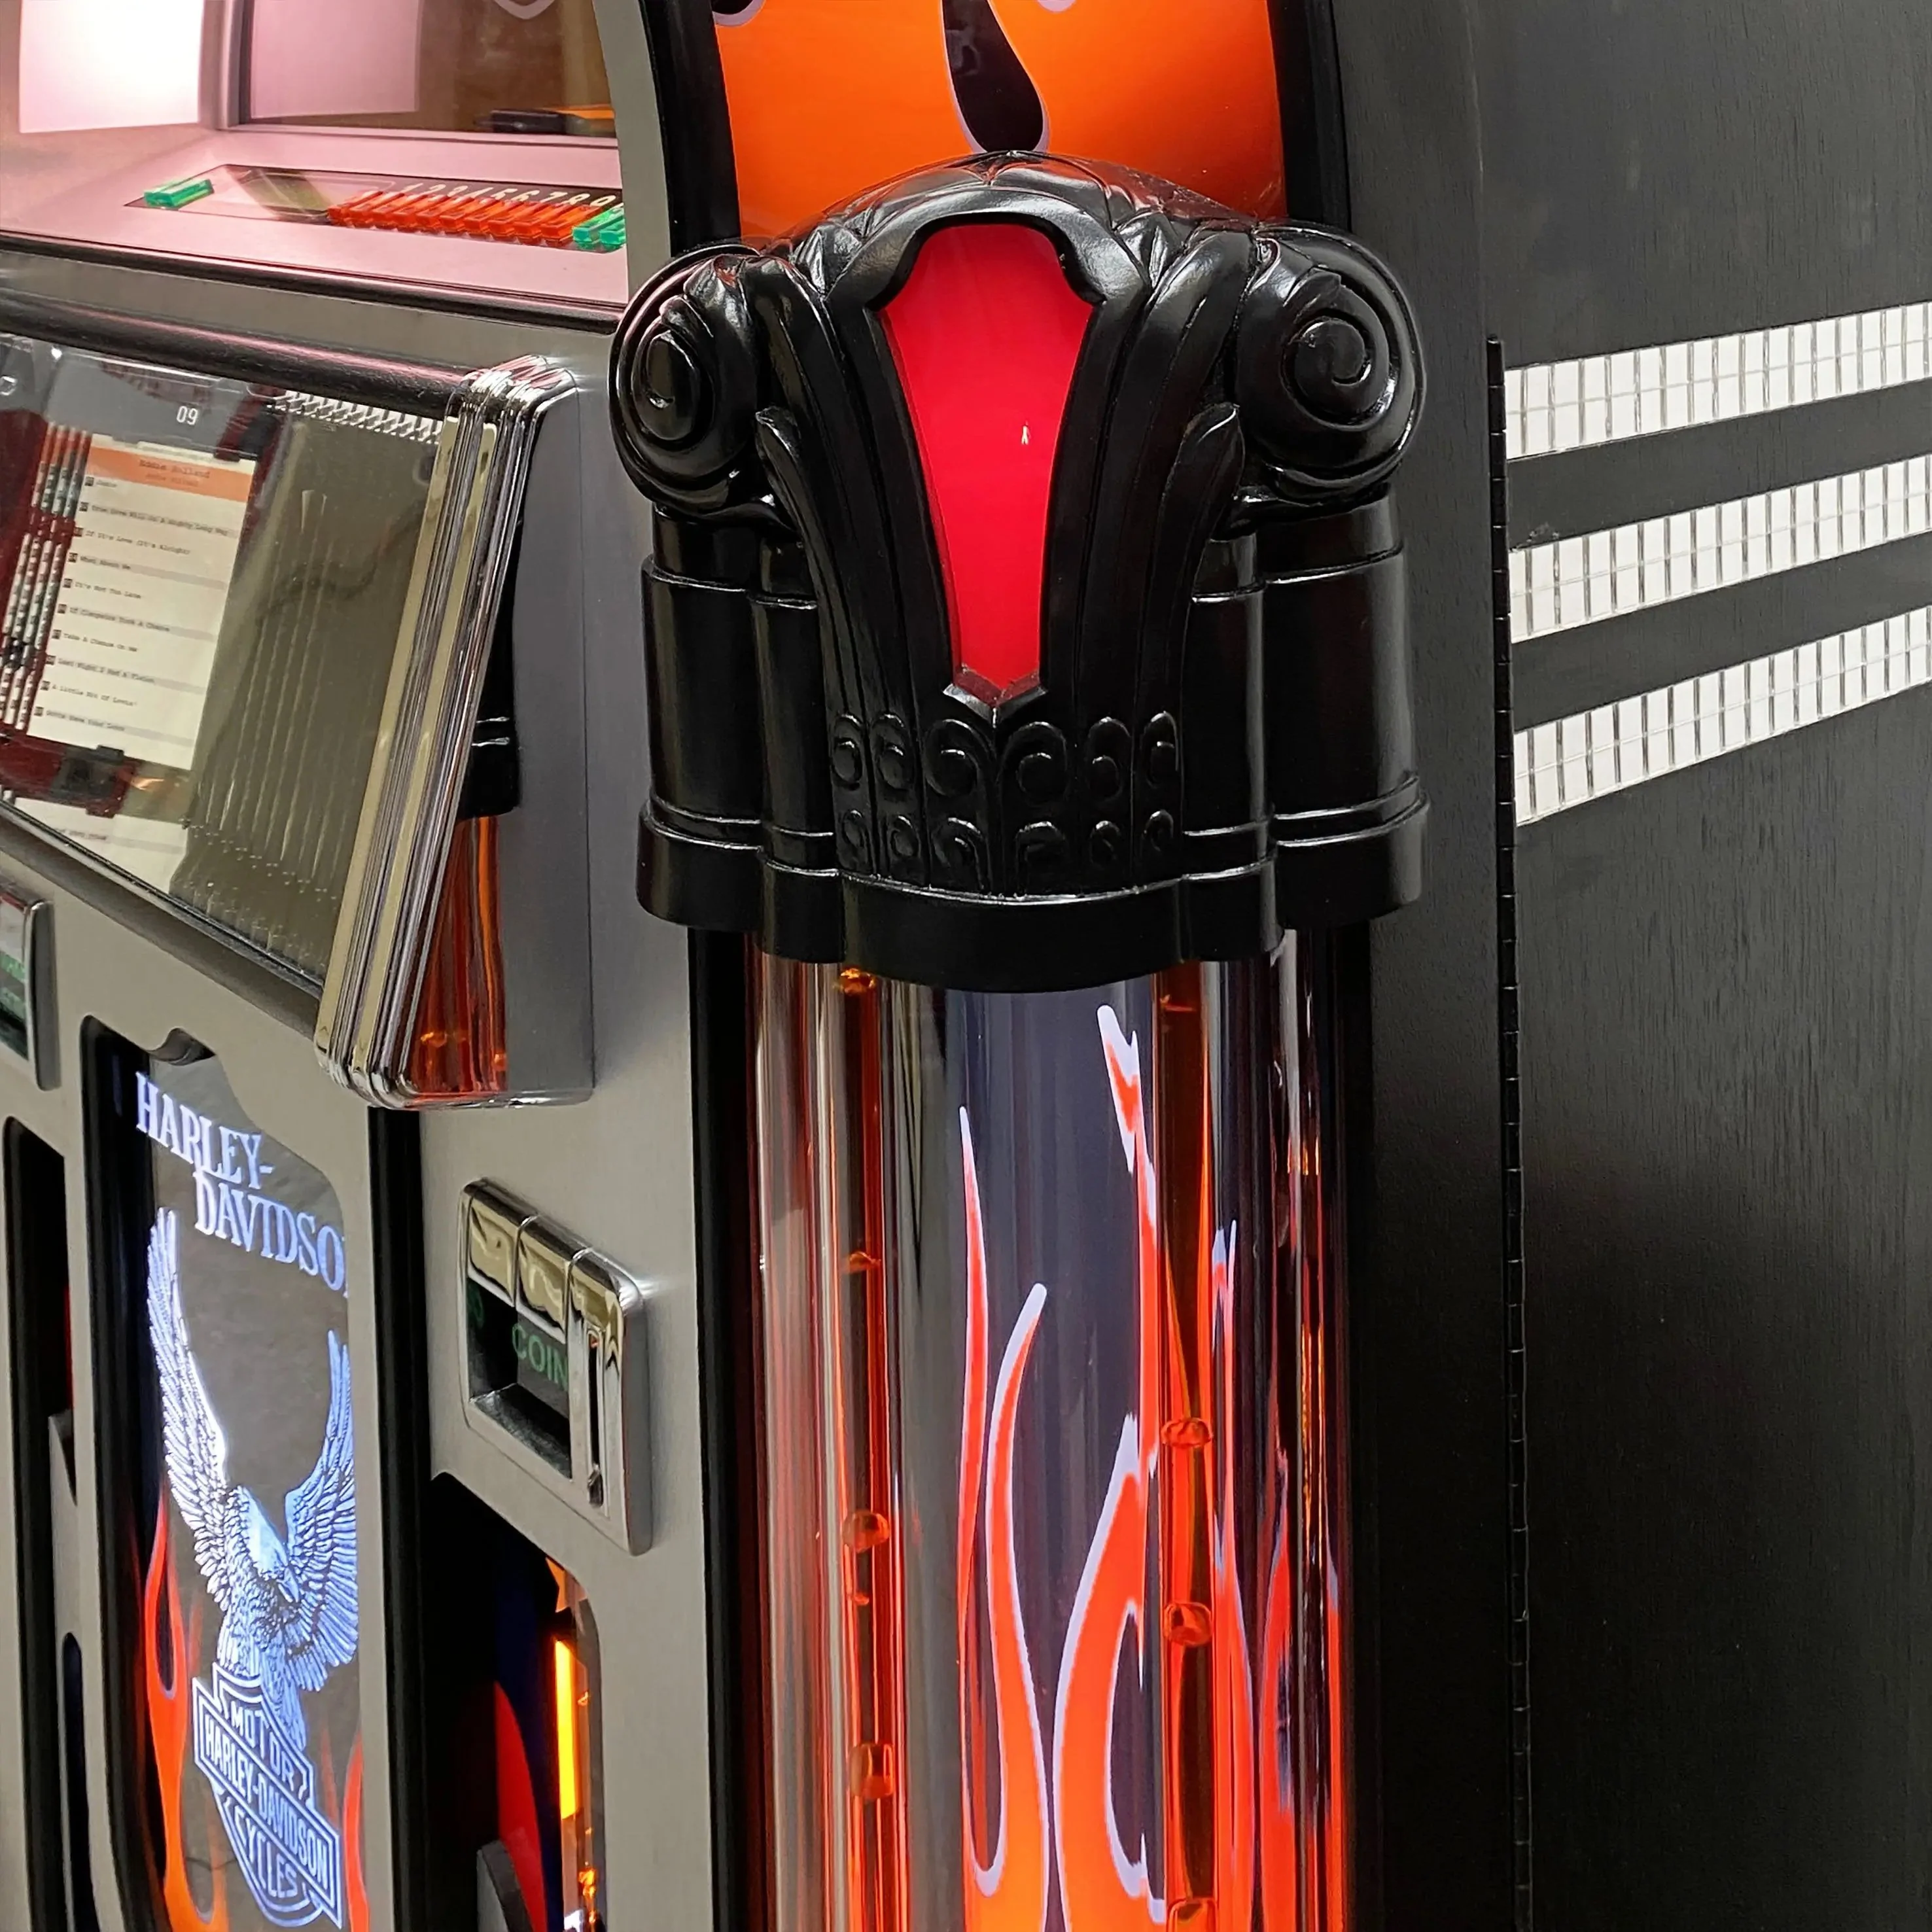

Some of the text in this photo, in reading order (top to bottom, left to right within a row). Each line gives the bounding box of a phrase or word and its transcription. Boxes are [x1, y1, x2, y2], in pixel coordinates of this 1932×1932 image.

[177, 406, 198, 425] 09
[135, 1072, 275, 1190] HARLEY-
[192, 1170, 349, 1299] DAVIDSO
[512, 1322, 569, 1393] COIN
[231, 1700, 295, 1791] MOTOR
[204, 1713, 328, 1891] HARLEY-DAVIDSON
[234, 1804, 298, 1898] CYCLES
